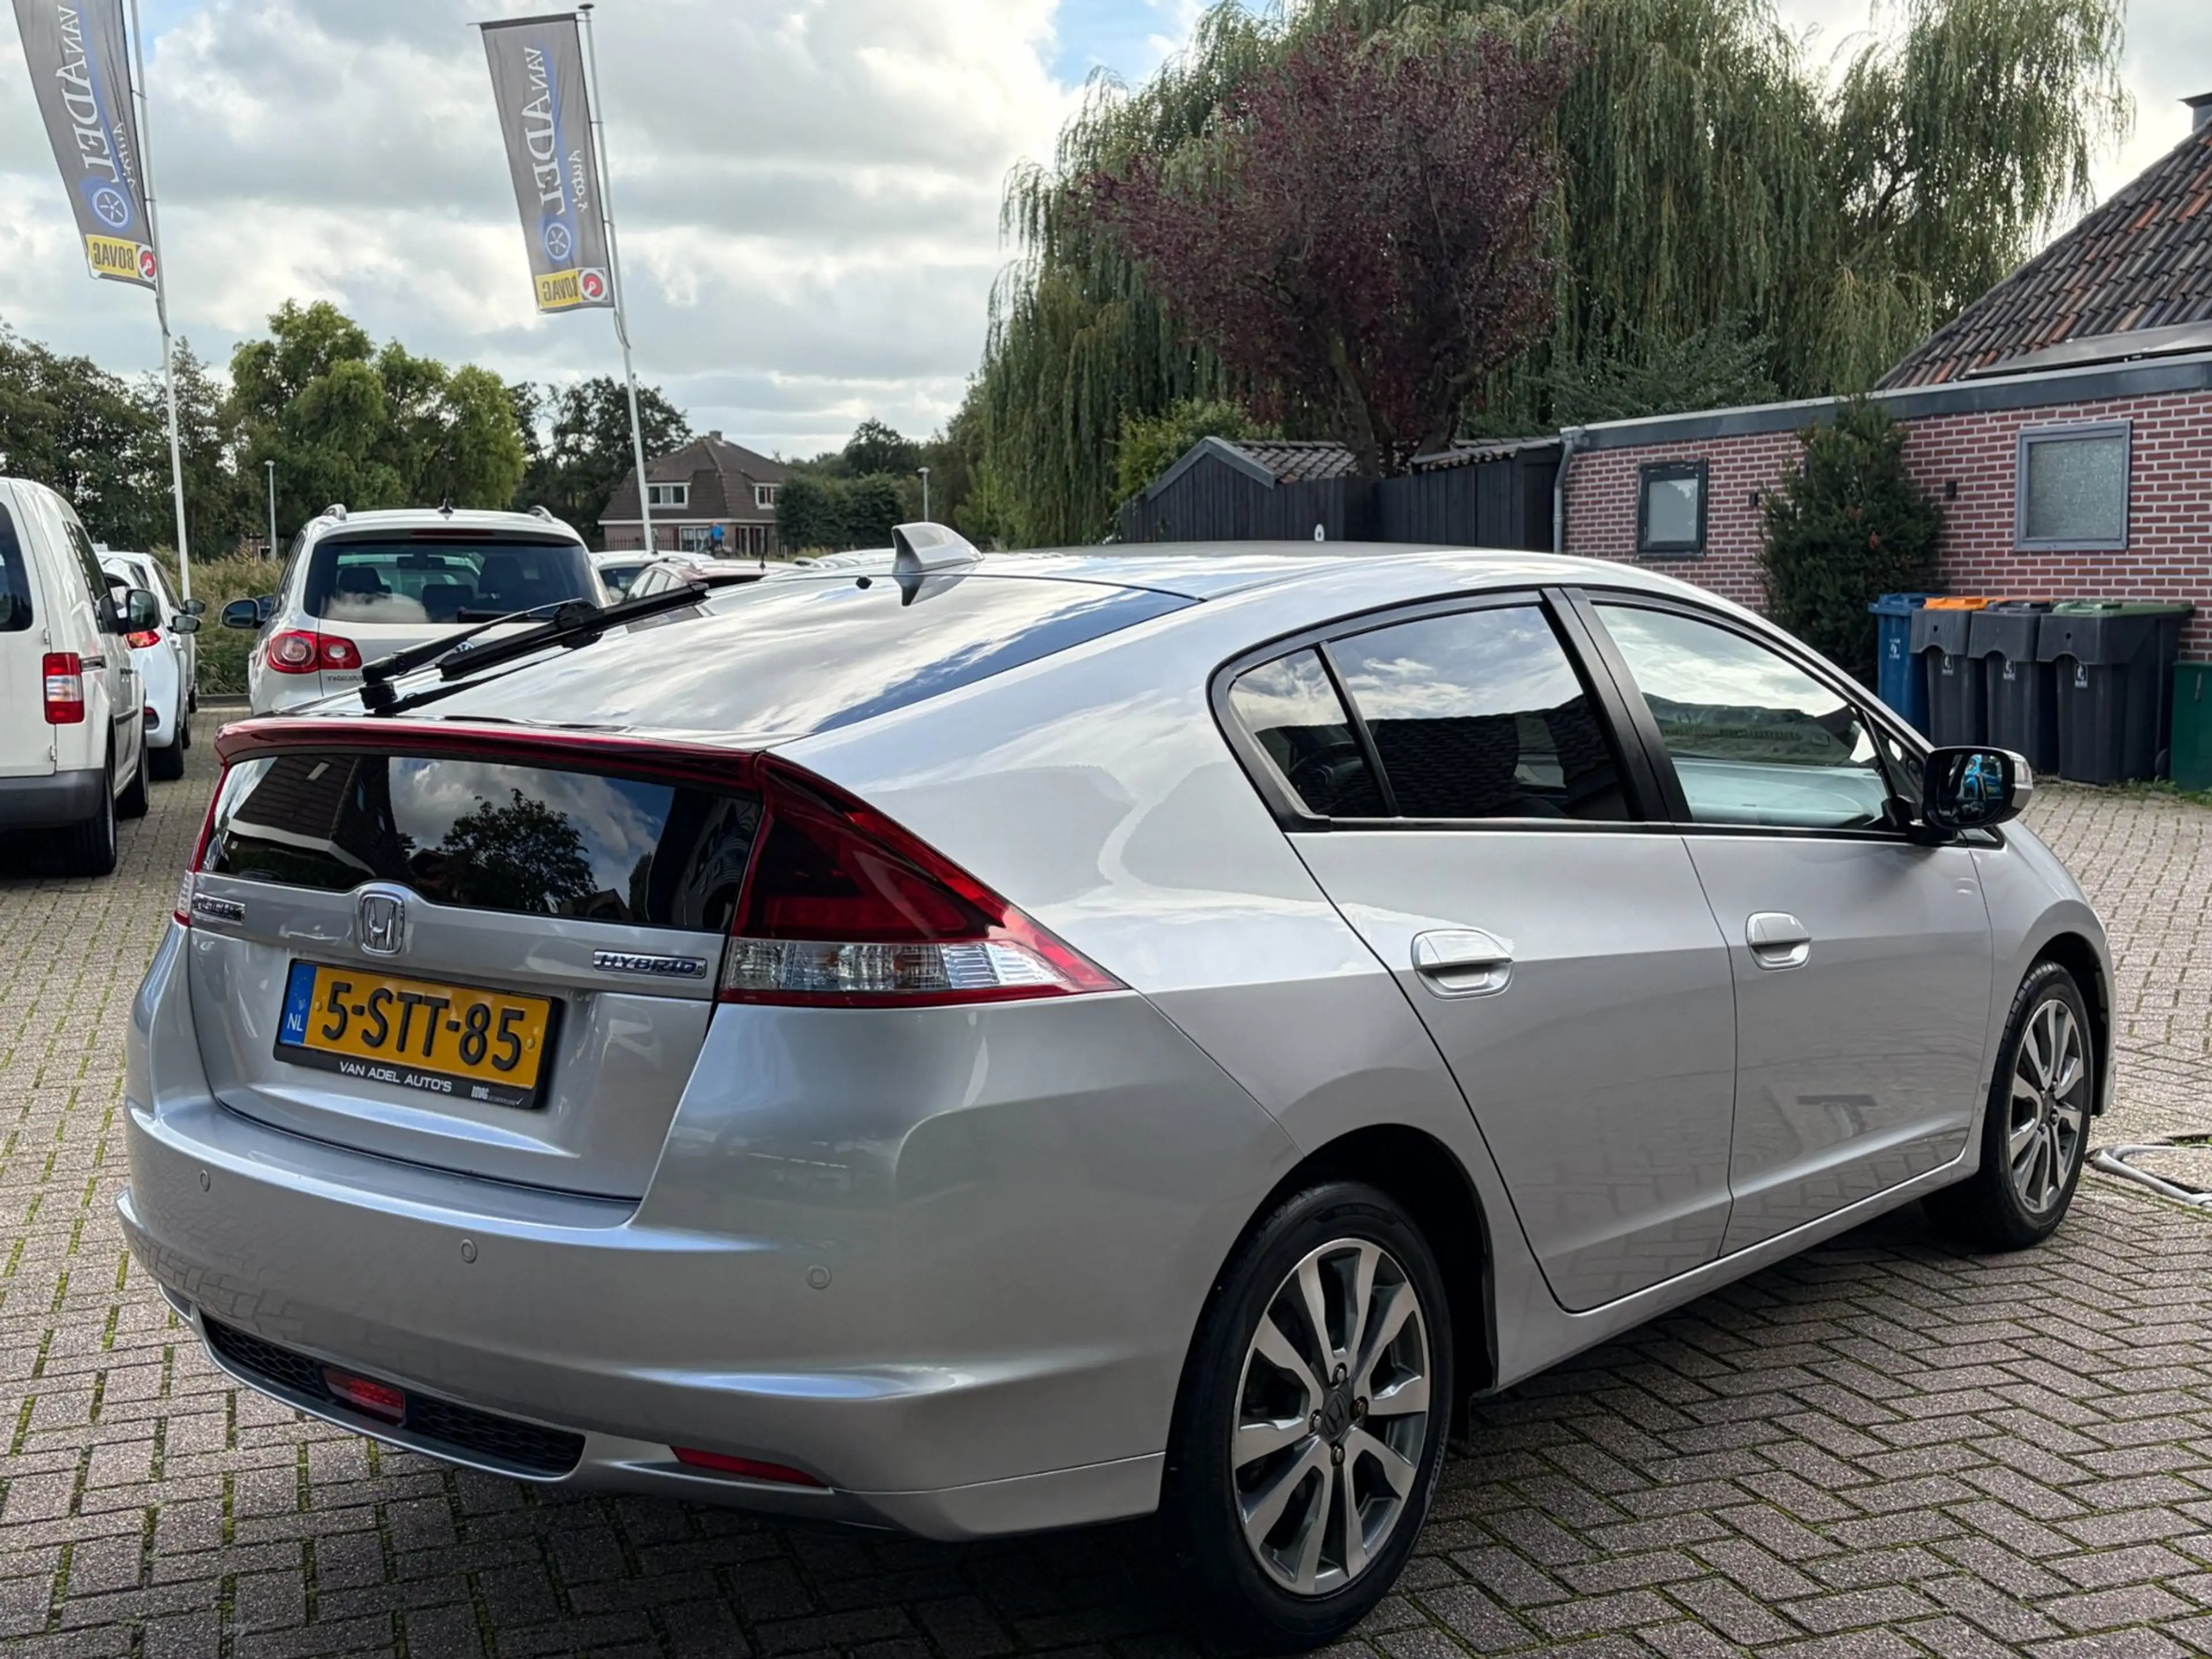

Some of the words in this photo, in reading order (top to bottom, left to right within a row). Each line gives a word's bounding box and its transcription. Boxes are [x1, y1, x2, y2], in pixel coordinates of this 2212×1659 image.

[600, 955, 697, 975] HYBRID
[287, 1012, 303, 1031] NL
[321, 980, 525, 1071] 5-STT-85
[340, 1060, 365, 1077] VAN
[368, 1067, 400, 1084] ADEL
[404, 1074, 452, 1092] AUTO'S
